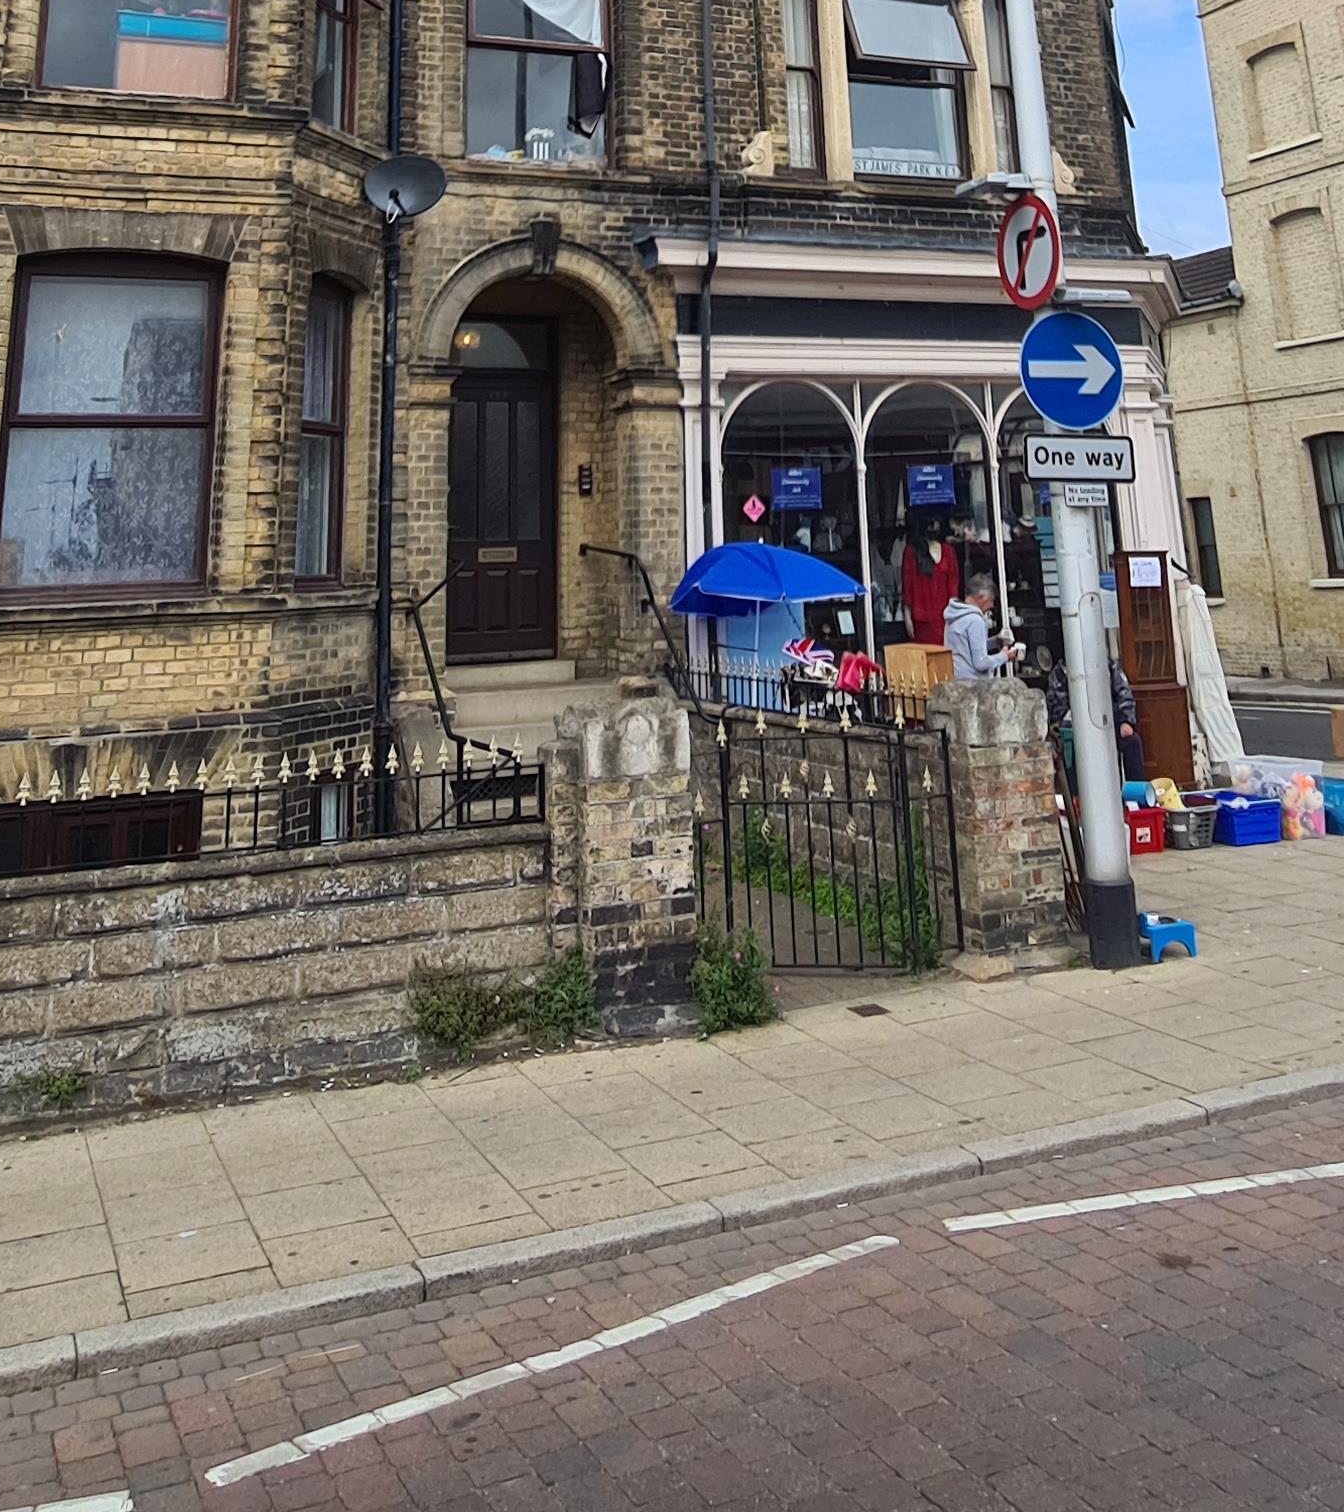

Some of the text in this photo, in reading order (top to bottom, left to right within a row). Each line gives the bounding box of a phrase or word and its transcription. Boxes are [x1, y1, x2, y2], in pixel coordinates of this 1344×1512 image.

[907, 162, 931, 176] PARK
[1034, 446, 1124, 470] One way
